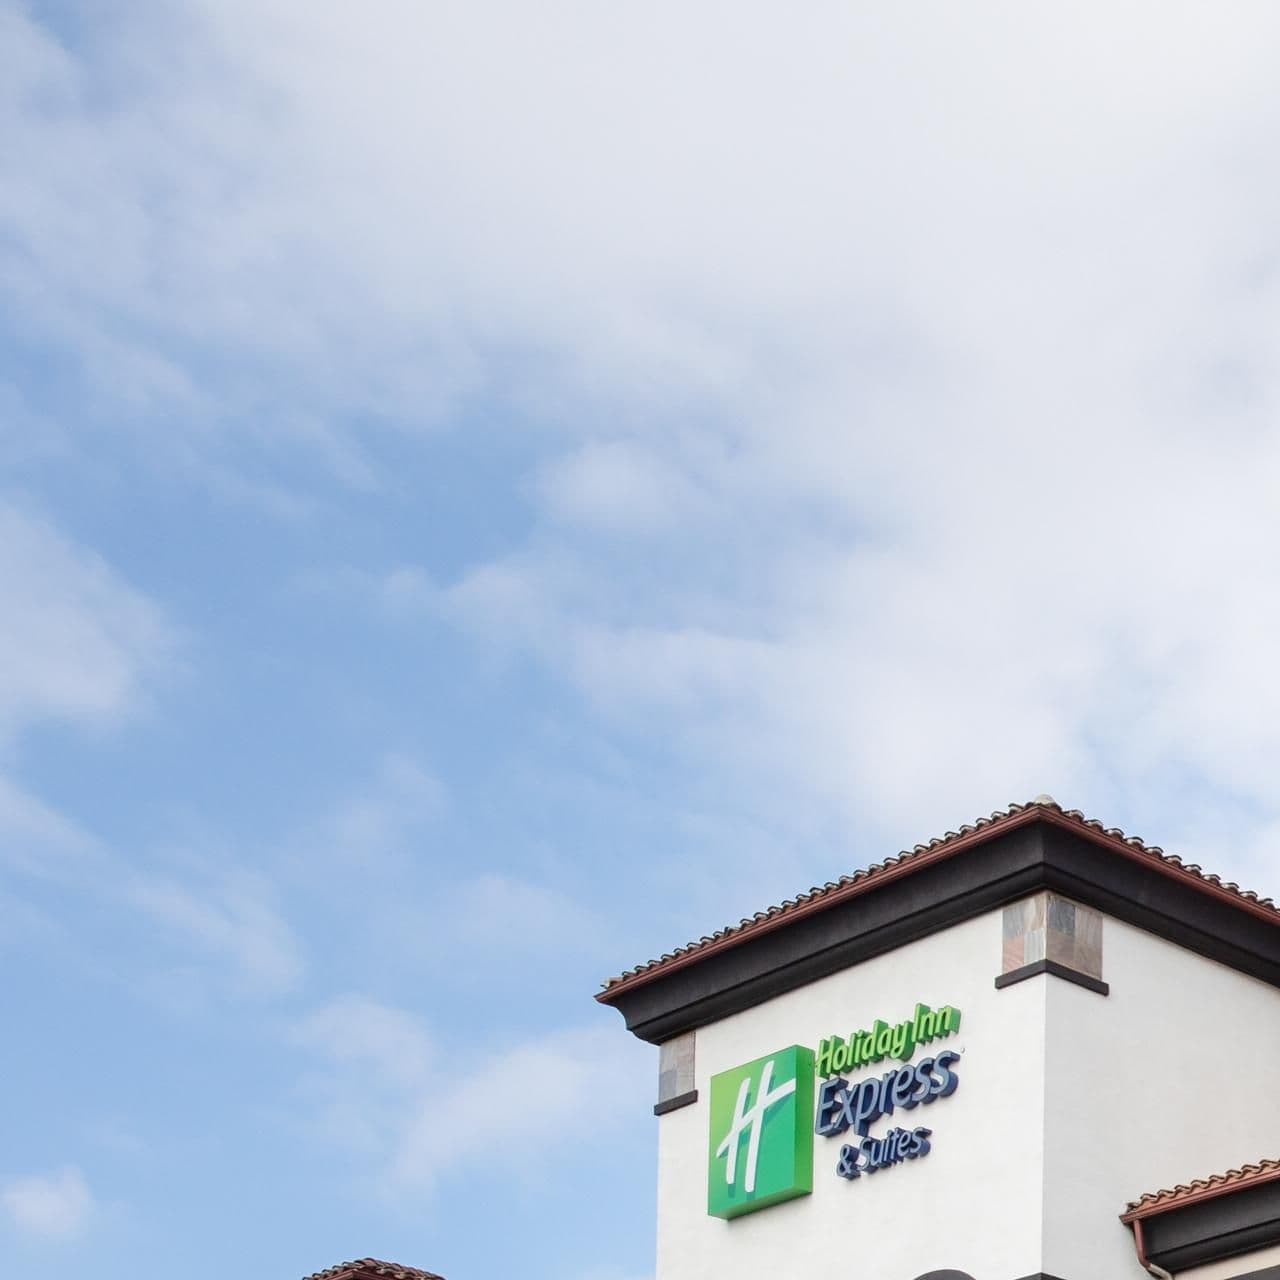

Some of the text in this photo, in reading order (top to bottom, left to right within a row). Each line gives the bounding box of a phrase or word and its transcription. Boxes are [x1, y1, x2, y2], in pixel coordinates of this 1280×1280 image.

[816, 1003, 961, 1079] Holiday Inn
[815, 1050, 960, 1137] Express
[836, 1127, 932, 1181] & Suites
